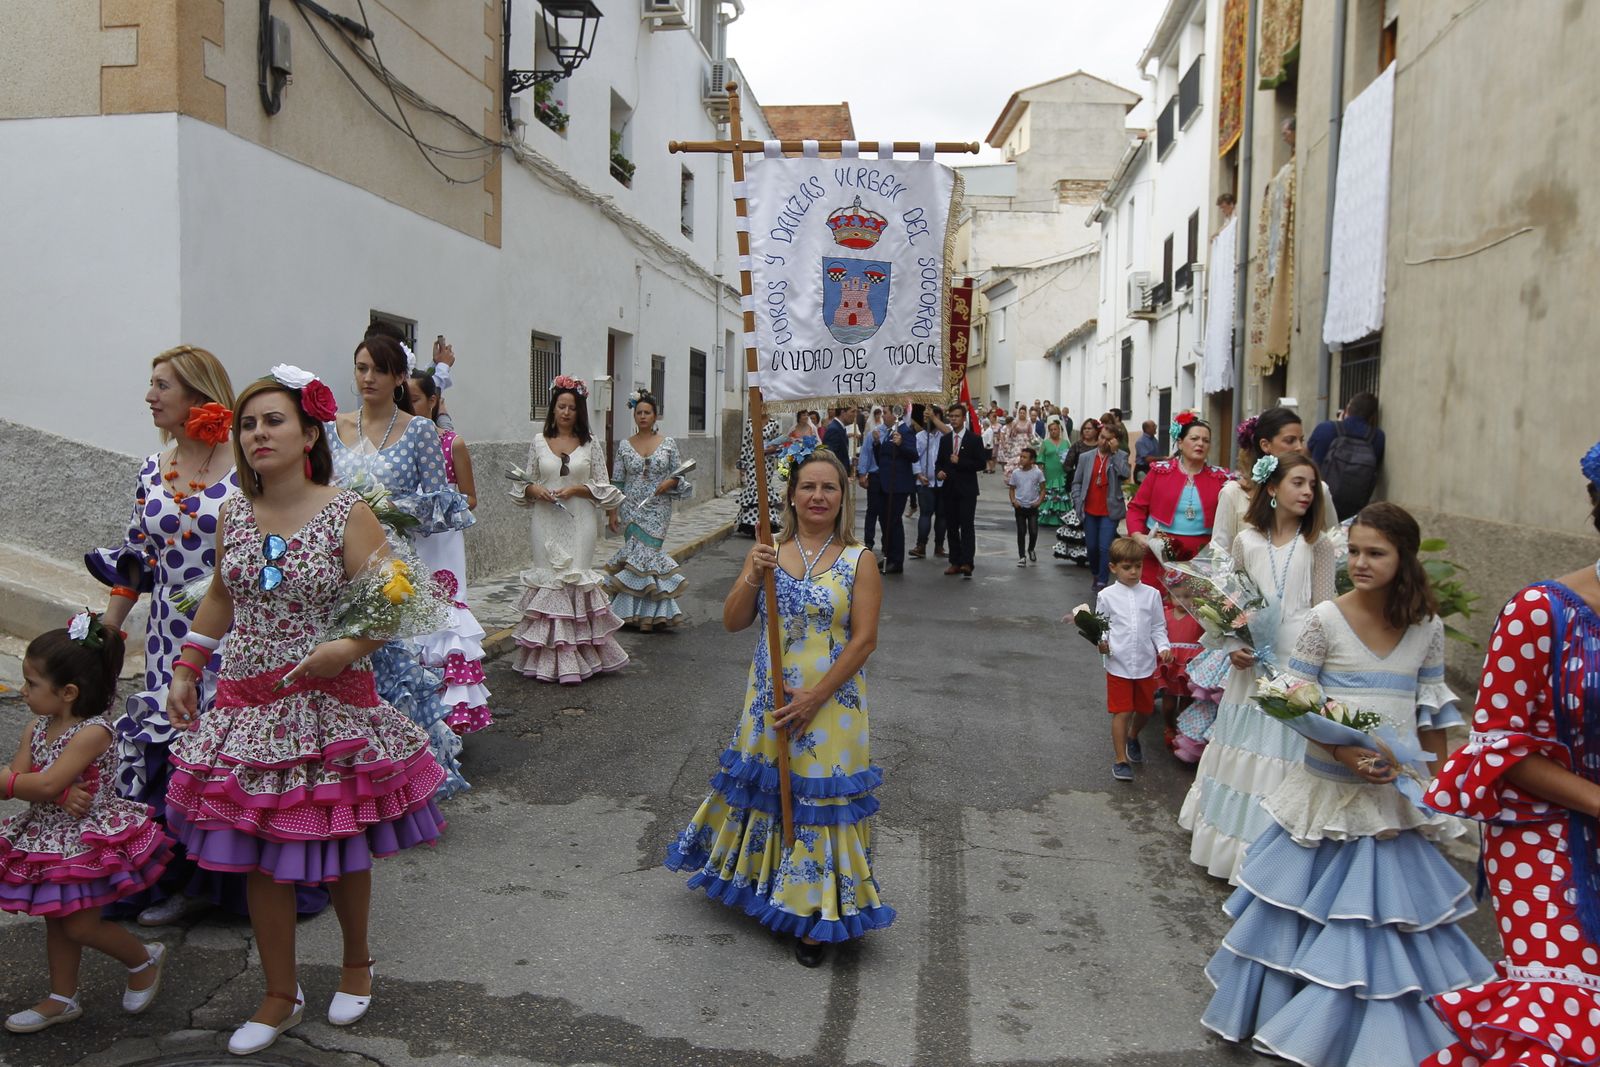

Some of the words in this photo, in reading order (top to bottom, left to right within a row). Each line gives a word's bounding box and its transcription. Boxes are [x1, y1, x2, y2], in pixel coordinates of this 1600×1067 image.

[834, 166, 907, 203] VIRGEN
[770, 176, 825, 244] DANZAS
[902, 207, 930, 246] DEL
[767, 280, 793, 345] COROS
[911, 257, 938, 339] SOCORRO
[771, 348, 833, 372] CIUDAD
[842, 347, 868, 370] DE
[884, 342, 938, 366] TIJOLA
[832, 371, 877, 394] 1993
